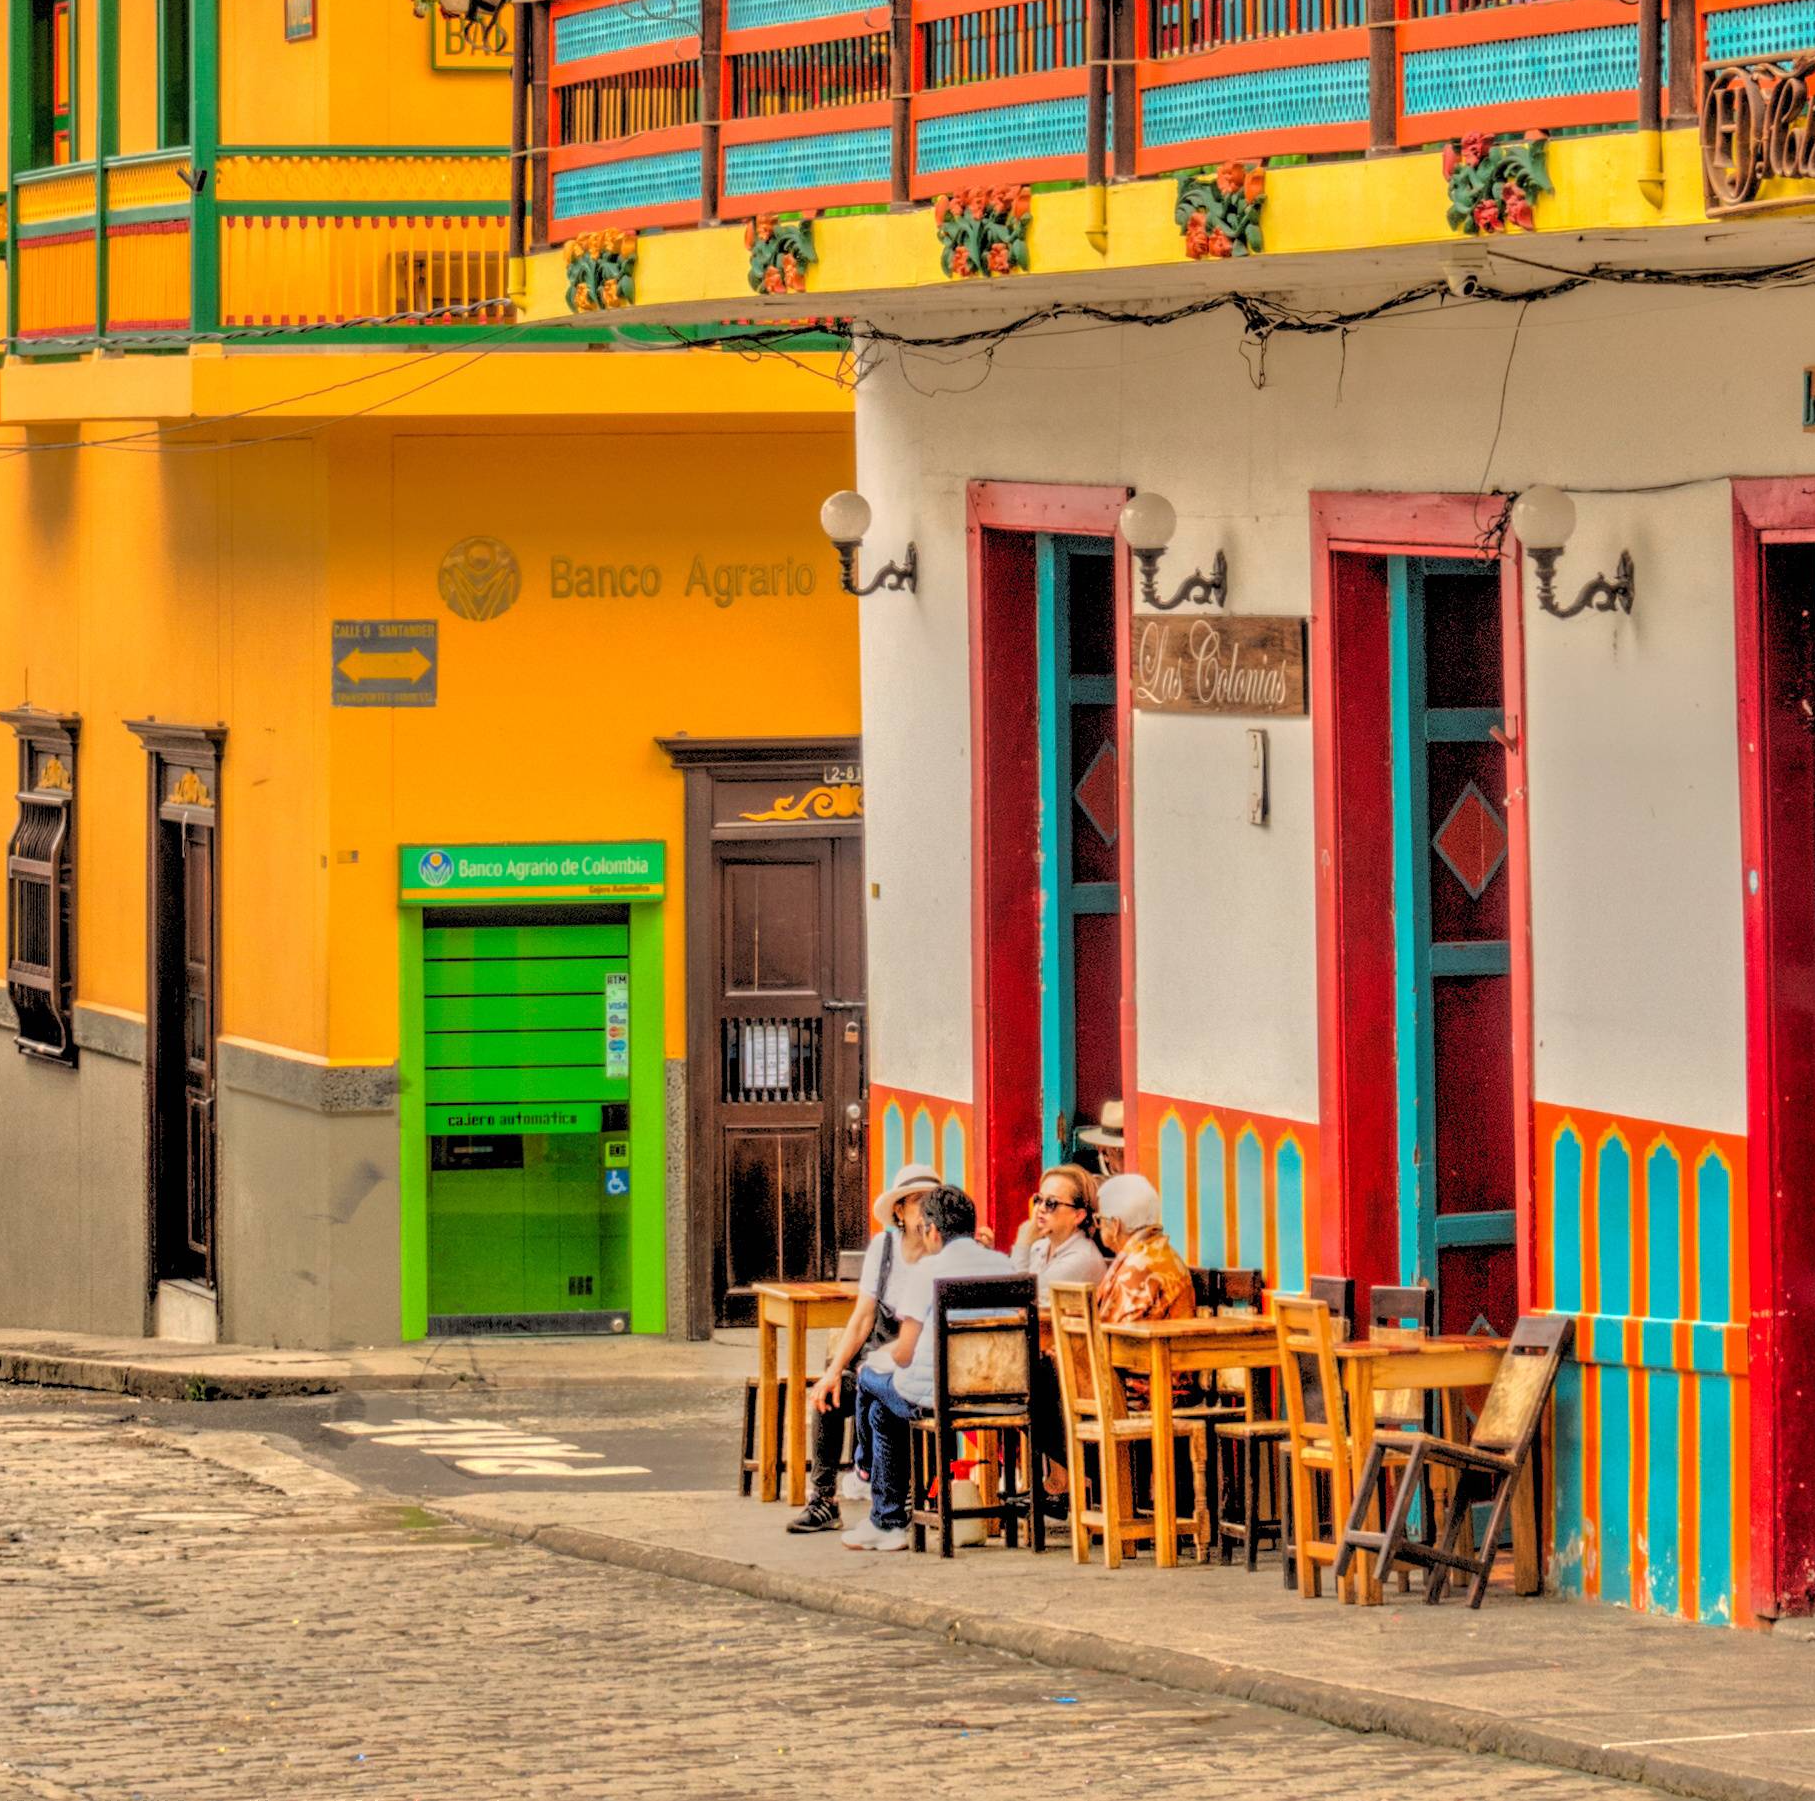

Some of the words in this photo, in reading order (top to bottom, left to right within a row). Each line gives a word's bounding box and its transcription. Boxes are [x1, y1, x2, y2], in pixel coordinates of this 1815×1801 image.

[550, 557, 662, 598] Banco
[685, 553, 817, 608] Agrario
[1137, 621, 1183, 704] Las
[1189, 619, 1287, 705] Colonias
[459, 859, 503, 878] Banco
[506, 857, 558, 880] Agrario
[561, 857, 578, 875] de
[582, 855, 649, 875] Colombia
